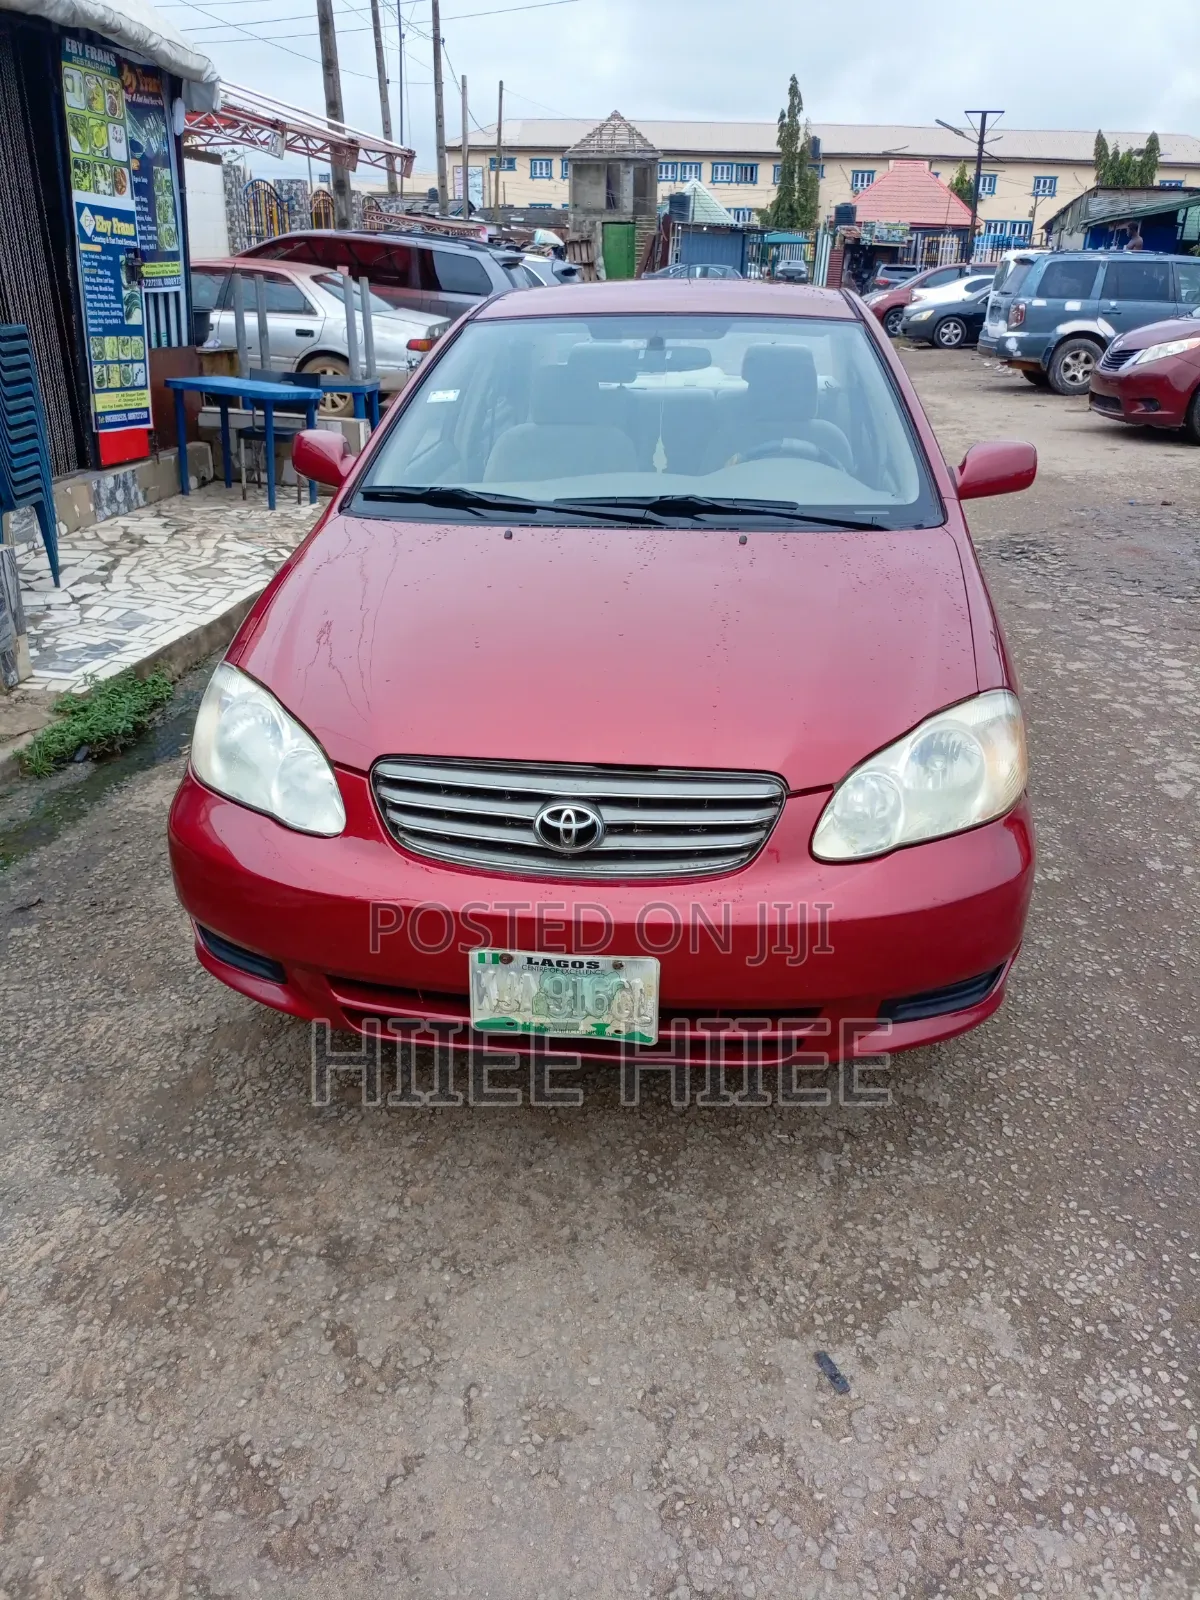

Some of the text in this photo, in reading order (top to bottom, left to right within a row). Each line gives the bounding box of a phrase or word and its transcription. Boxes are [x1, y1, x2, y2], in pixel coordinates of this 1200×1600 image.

[72, 56, 111, 75] RESTAURANT
[521, 964, 548, 973] CENTRE
[560, 968, 605, 976] EXCELLENCE
[526, 956, 600, 970] LAGOS
